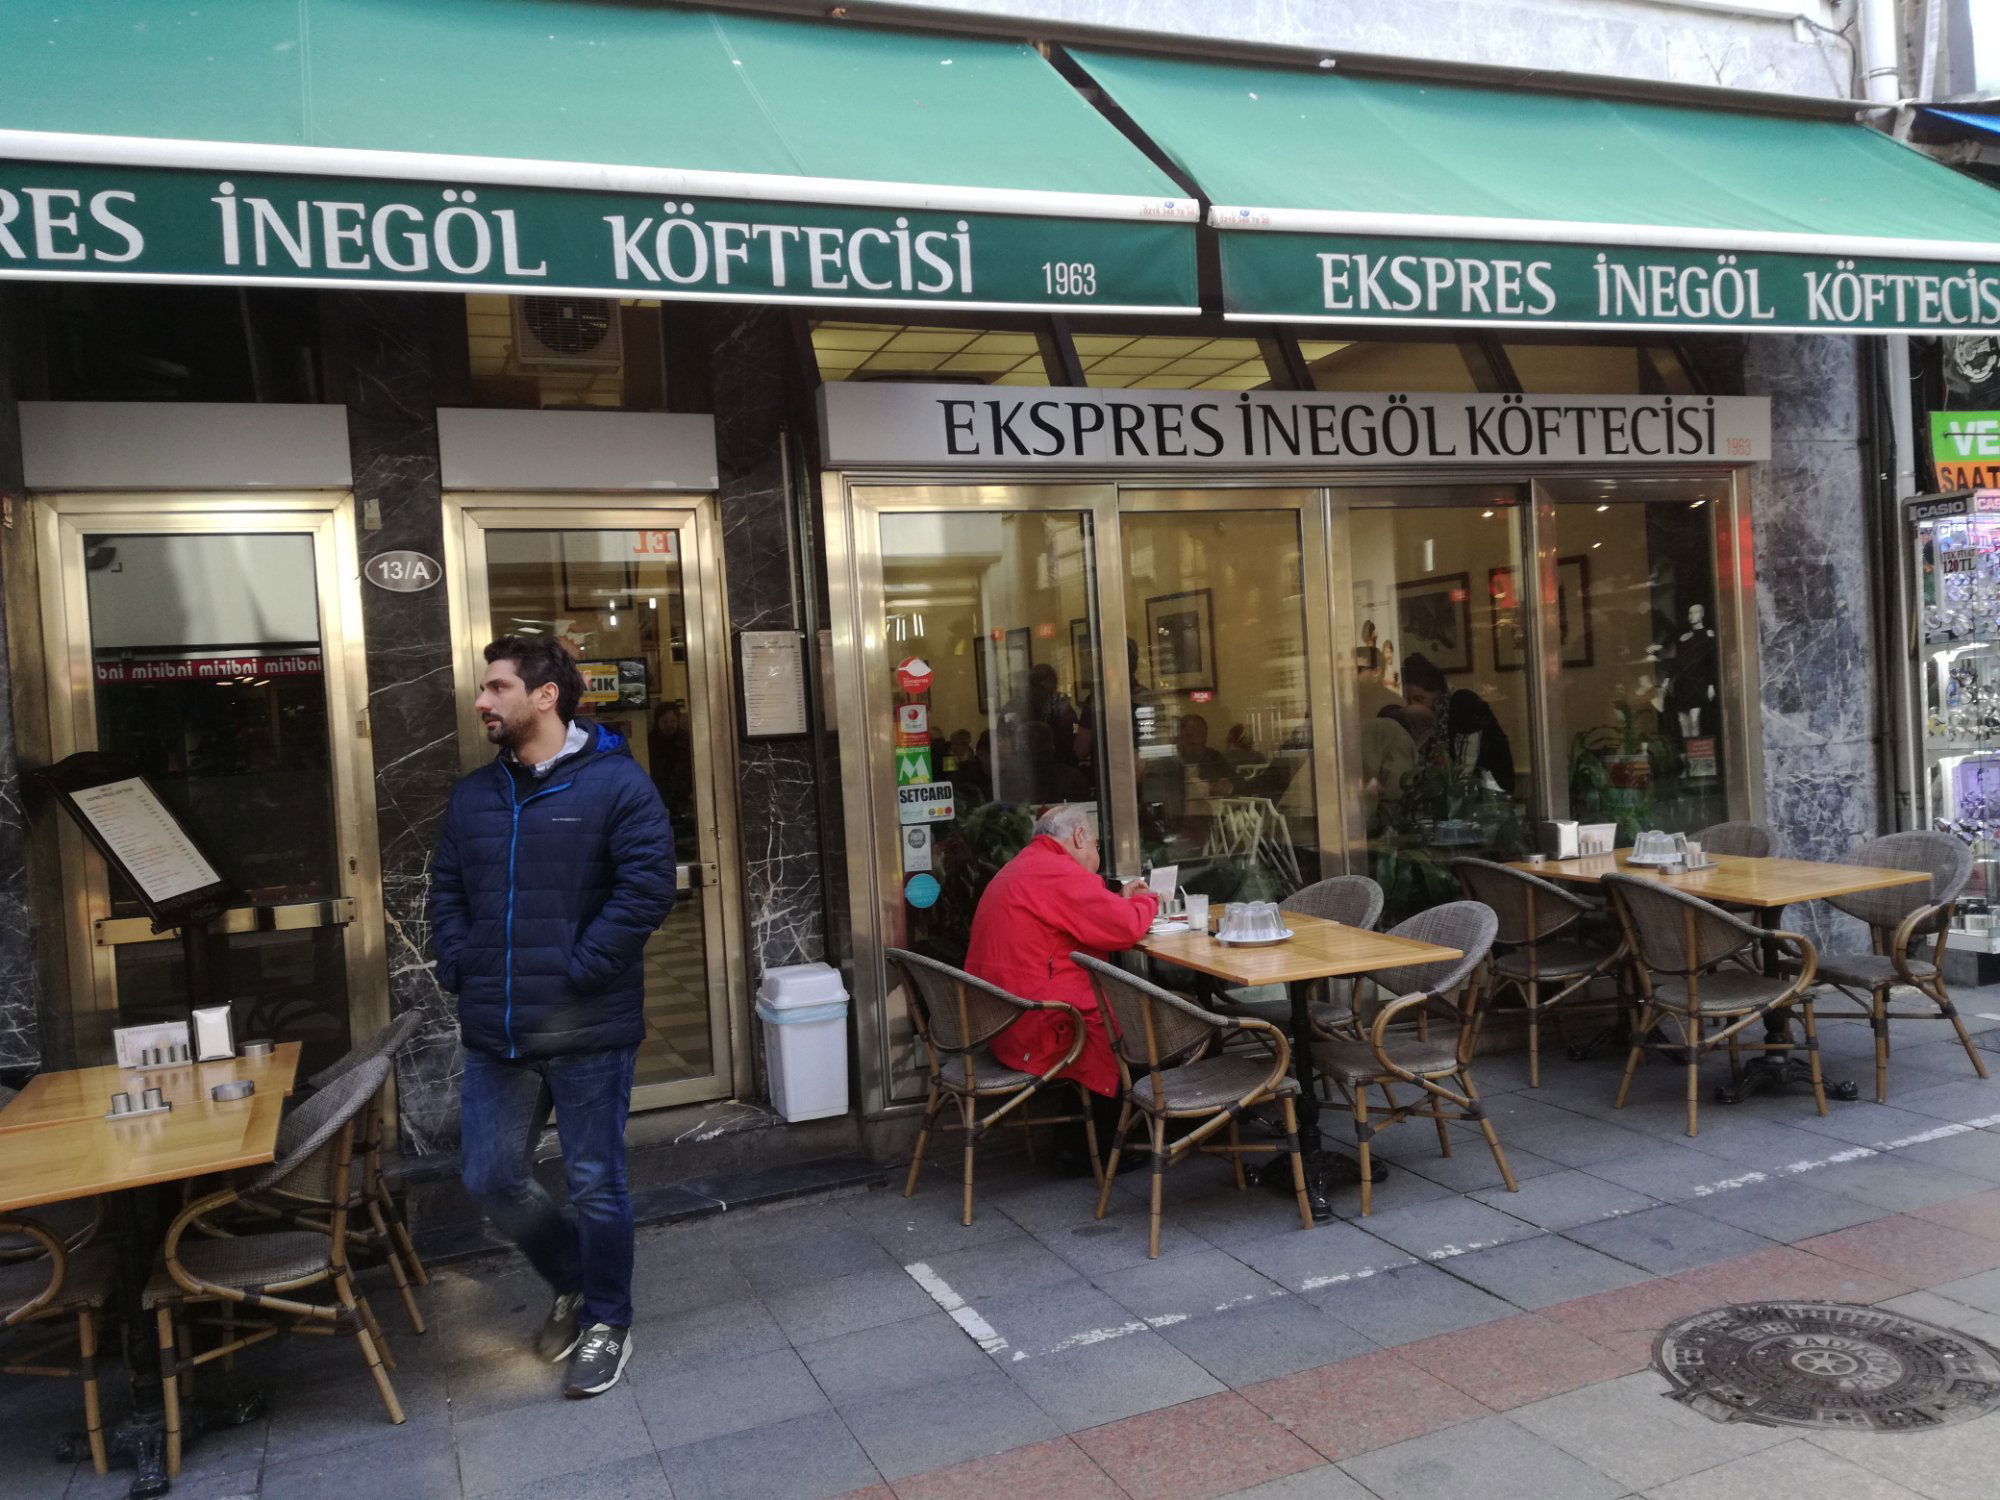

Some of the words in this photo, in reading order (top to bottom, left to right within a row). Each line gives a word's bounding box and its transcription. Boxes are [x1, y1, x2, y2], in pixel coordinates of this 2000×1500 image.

[212, 181, 547, 277] İNEGÖL
[603, 201, 973, 295] KÖFTECİSİ
[1042, 262, 1097, 297] 1963
[1316, 252, 1557, 315] EKSPRES
[1593, 253, 1775, 321] İNEGÖL
[1803, 260, 2000, 324] KÖFTECİS
[936, 399, 1224, 457] EKSPRES
[1237, 392, 1457, 457] İNEGÖL
[1465, 393, 1717, 457] KÖFTECİSİ
[1727, 437, 1751, 456] 1963
[1950, 420, 2000, 456] VE
[1917, 501, 1964, 519] CASIO
[378, 561, 430, 580] 13/A
[899, 785, 953, 804] SETCARD
